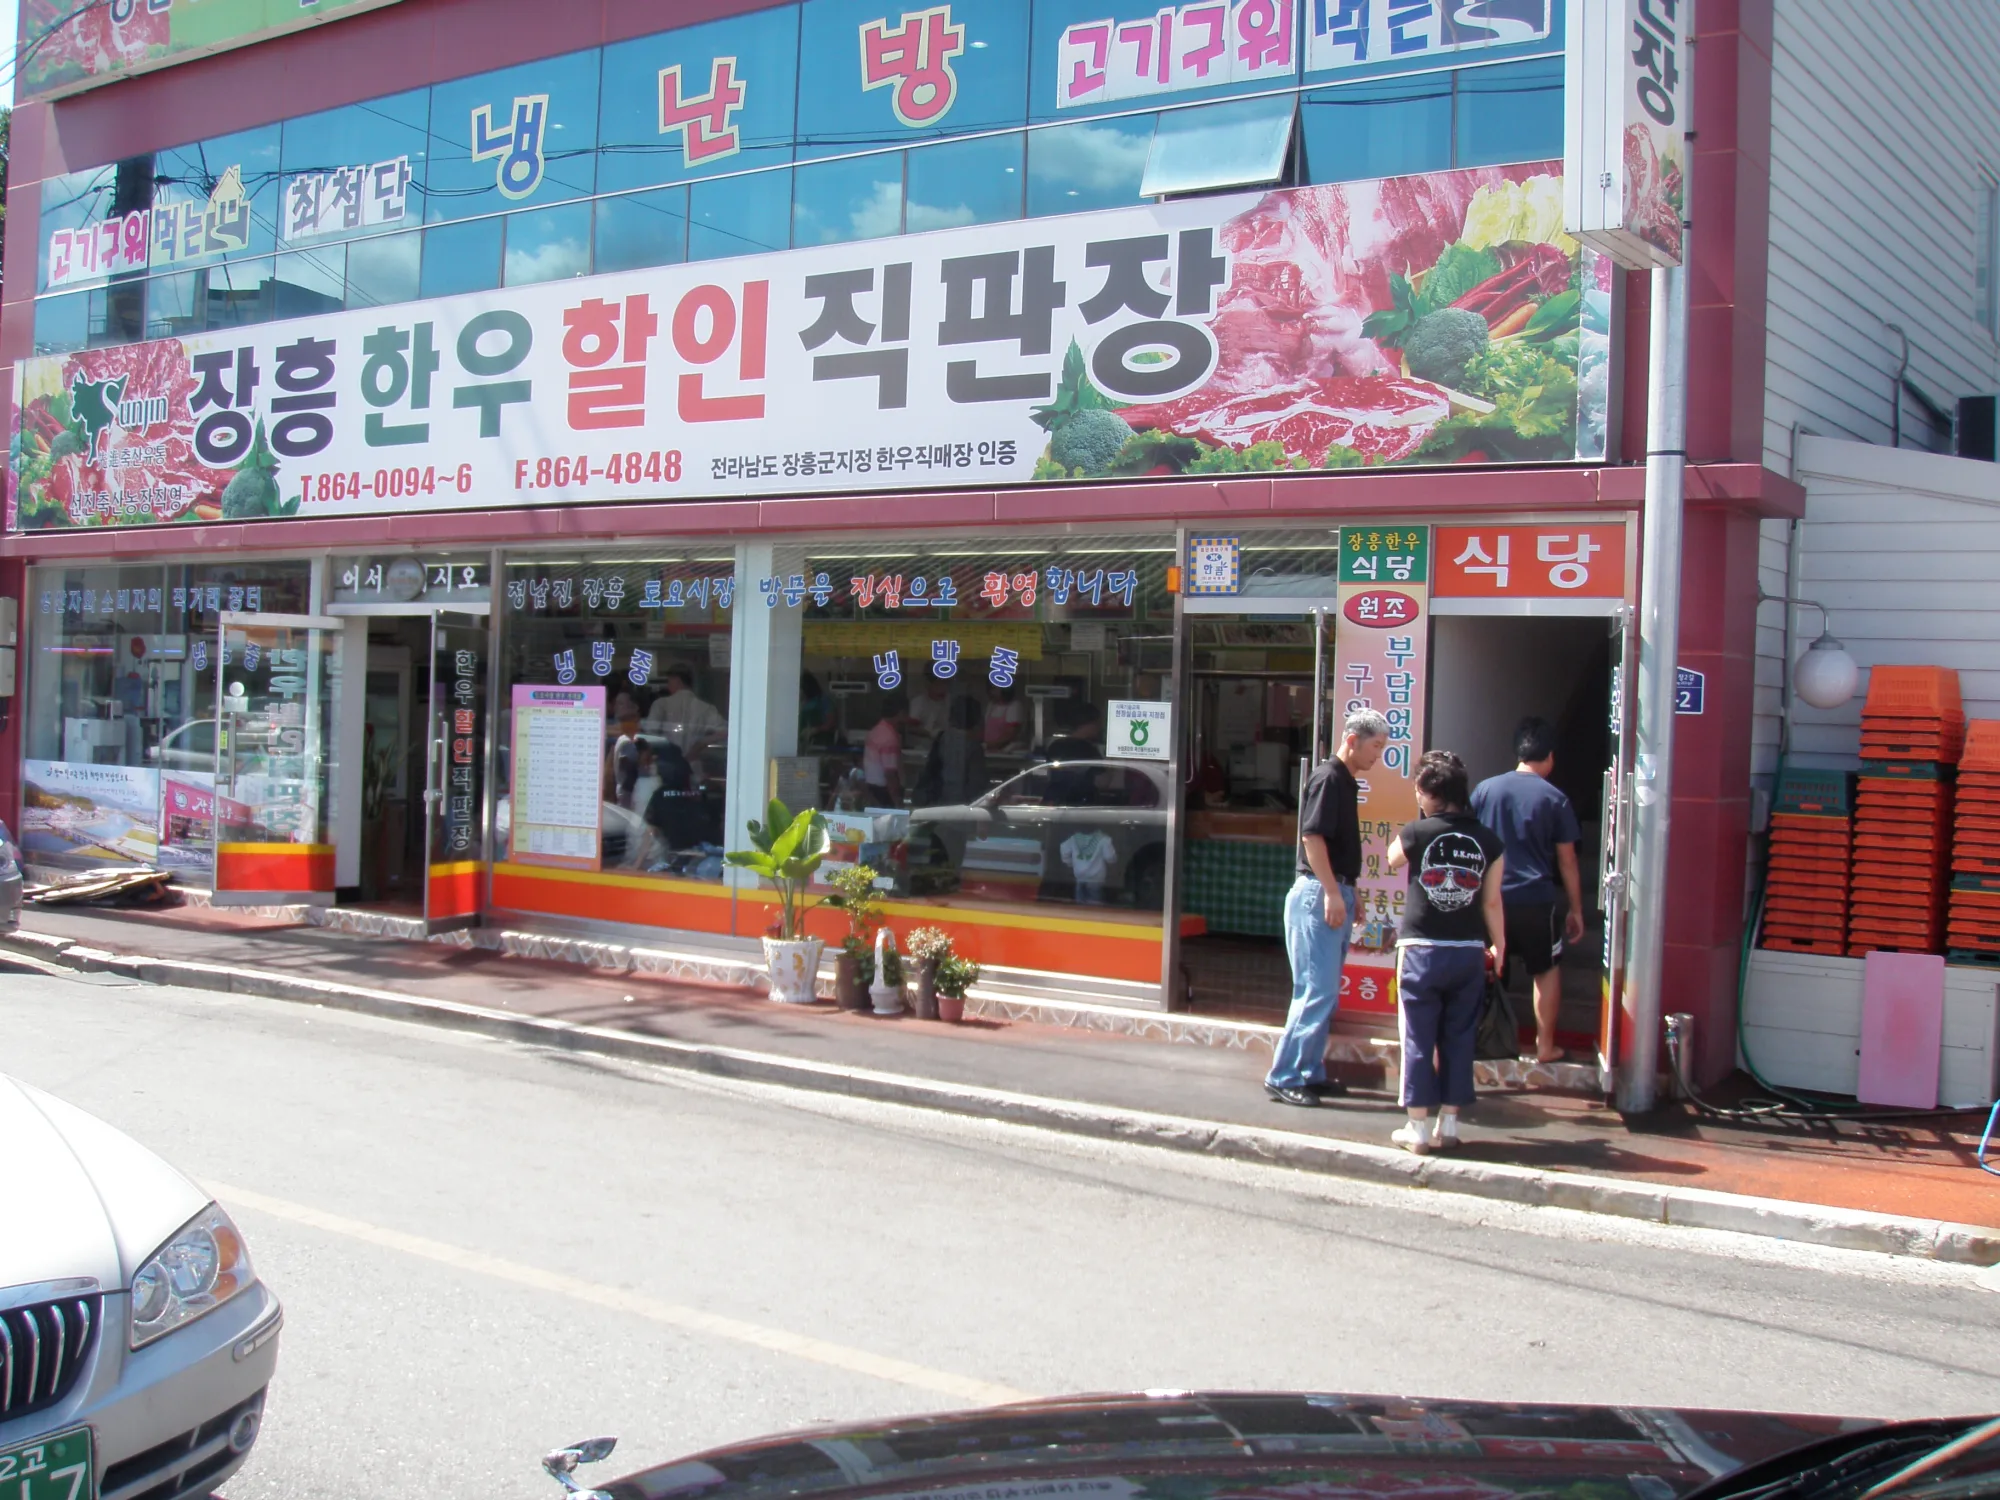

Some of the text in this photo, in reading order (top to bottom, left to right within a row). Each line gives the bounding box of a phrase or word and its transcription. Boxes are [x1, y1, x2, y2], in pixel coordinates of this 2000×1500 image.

[1068, 0, 1292, 99] 고기구워
[292, 162, 411, 232] 최첨단
[54, 211, 147, 281] 고기구워
[797, 227, 1226, 410] 직판장
[102, 381, 168, 437] Sunjin
[300, 449, 682, 503] T.864-0094~6 F.864-4848
[711, 440, 1017, 479] 전라남도 장흥군지정 한우직매장 인증
[1348, 532, 1420, 551] 장흥한우
[1352, 556, 1415, 580] 식당
[1453, 534, 1600, 588] 식당
[102, 588, 161, 613] 소비자의
[173, 587, 220, 613] 직거래
[229, 586, 261, 612] 장터
[508, 578, 572, 609] 정남진
[583, 577, 625, 609] 장흥
[639, 576, 736, 609] 토요시장
[759, 573, 833, 608] 방문을
[850, 574, 957, 609] 진심으로
[1358, 597, 1405, 619] 원조
[1384, 636, 1415, 777] 부담없이
